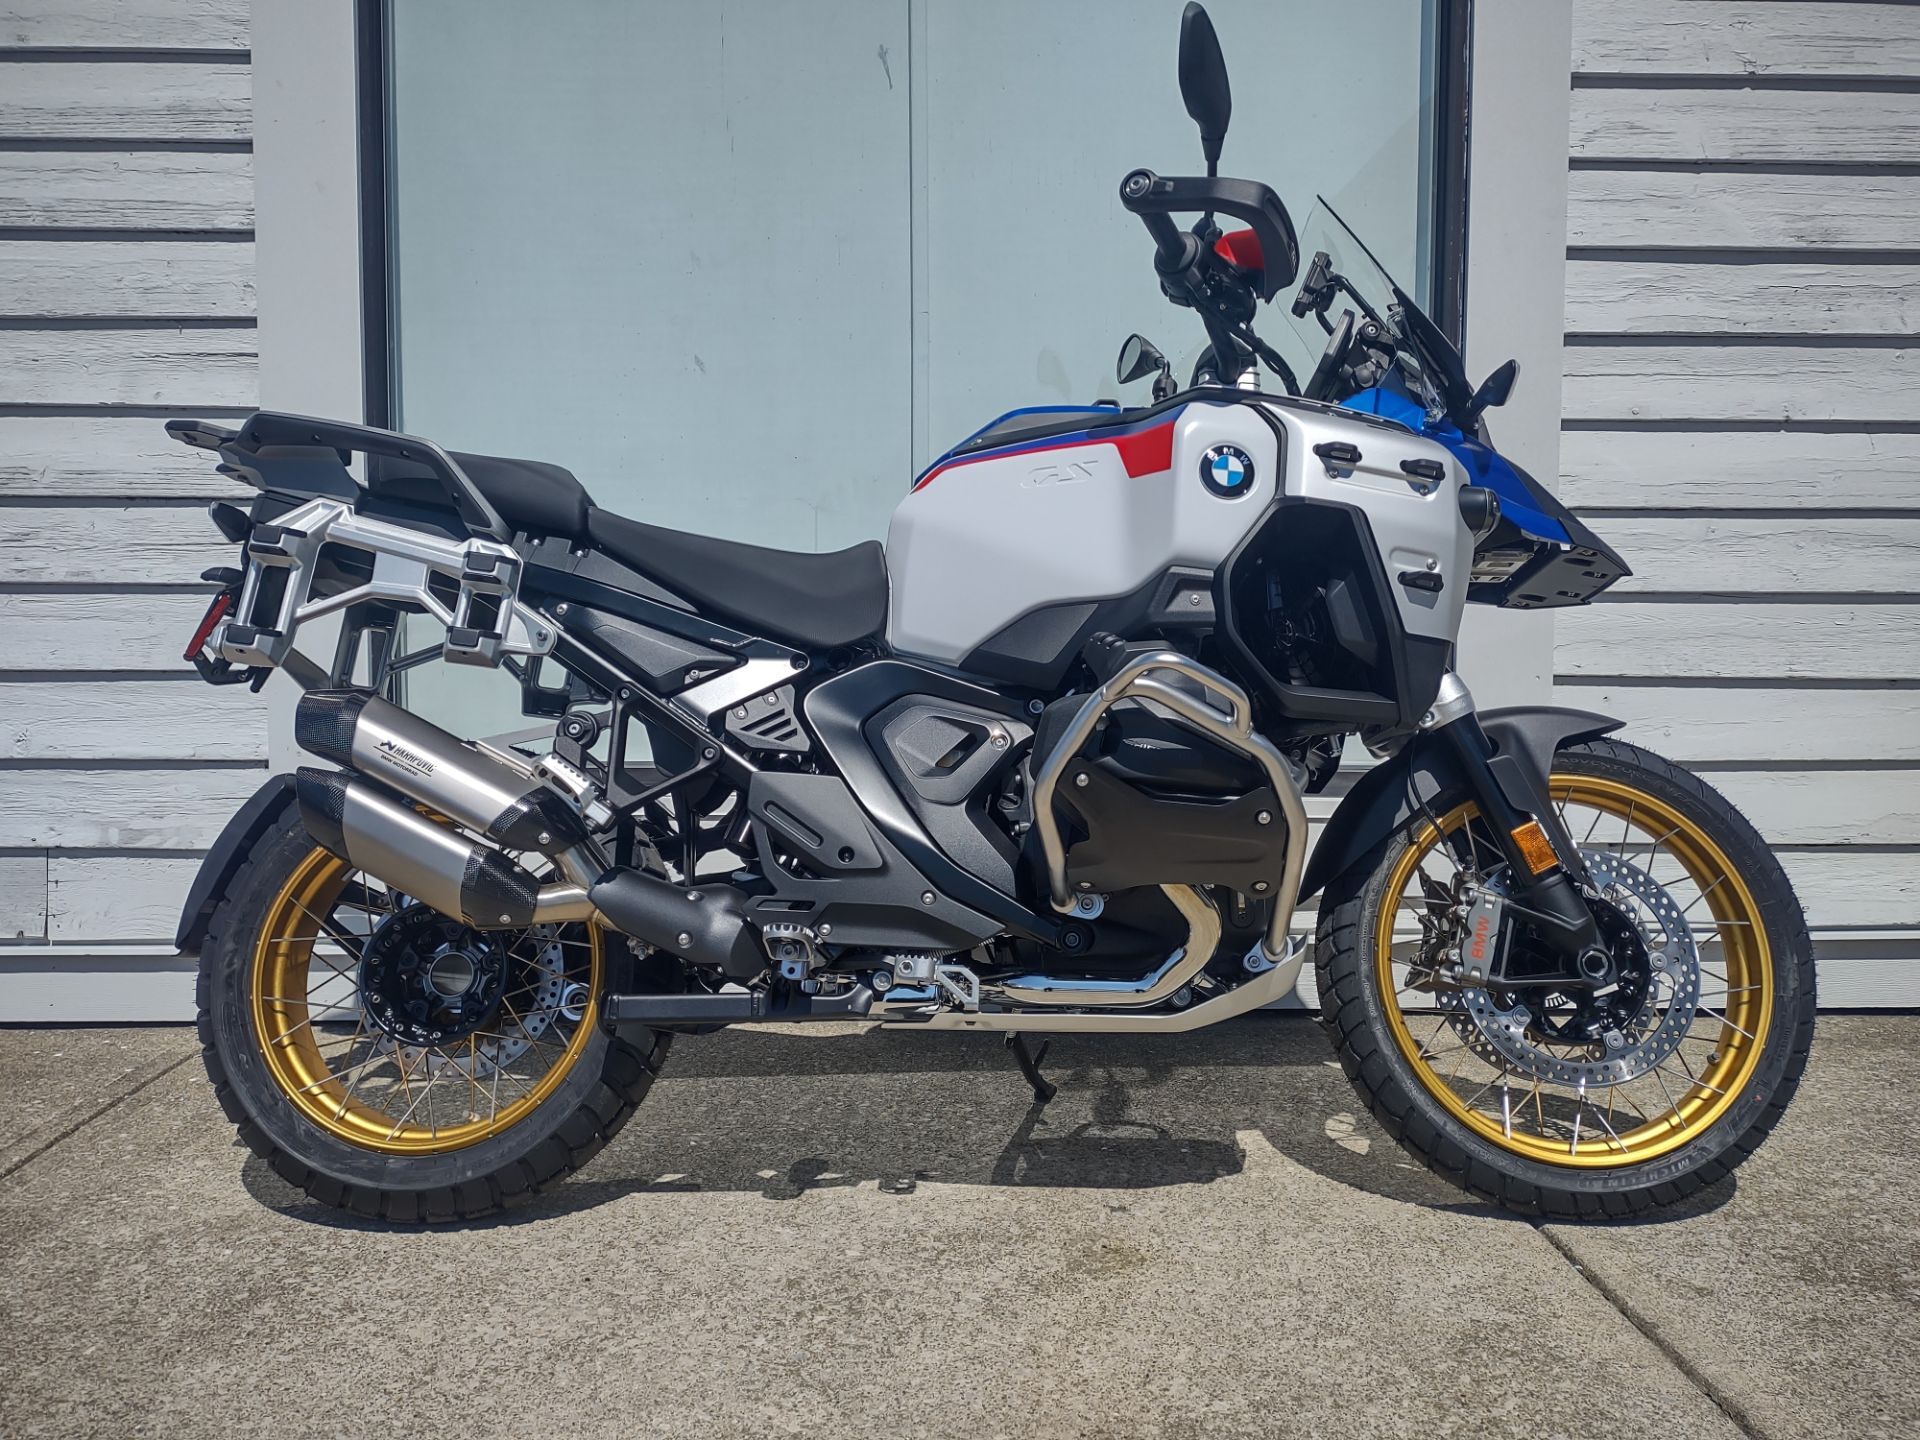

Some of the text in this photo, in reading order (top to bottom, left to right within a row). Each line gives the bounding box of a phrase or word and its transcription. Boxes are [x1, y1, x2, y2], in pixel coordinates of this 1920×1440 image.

[1207, 447, 1250, 465] BMW
[1471, 915, 1489, 960] BMW
[1606, 1156, 1691, 1188] MICHELIN
